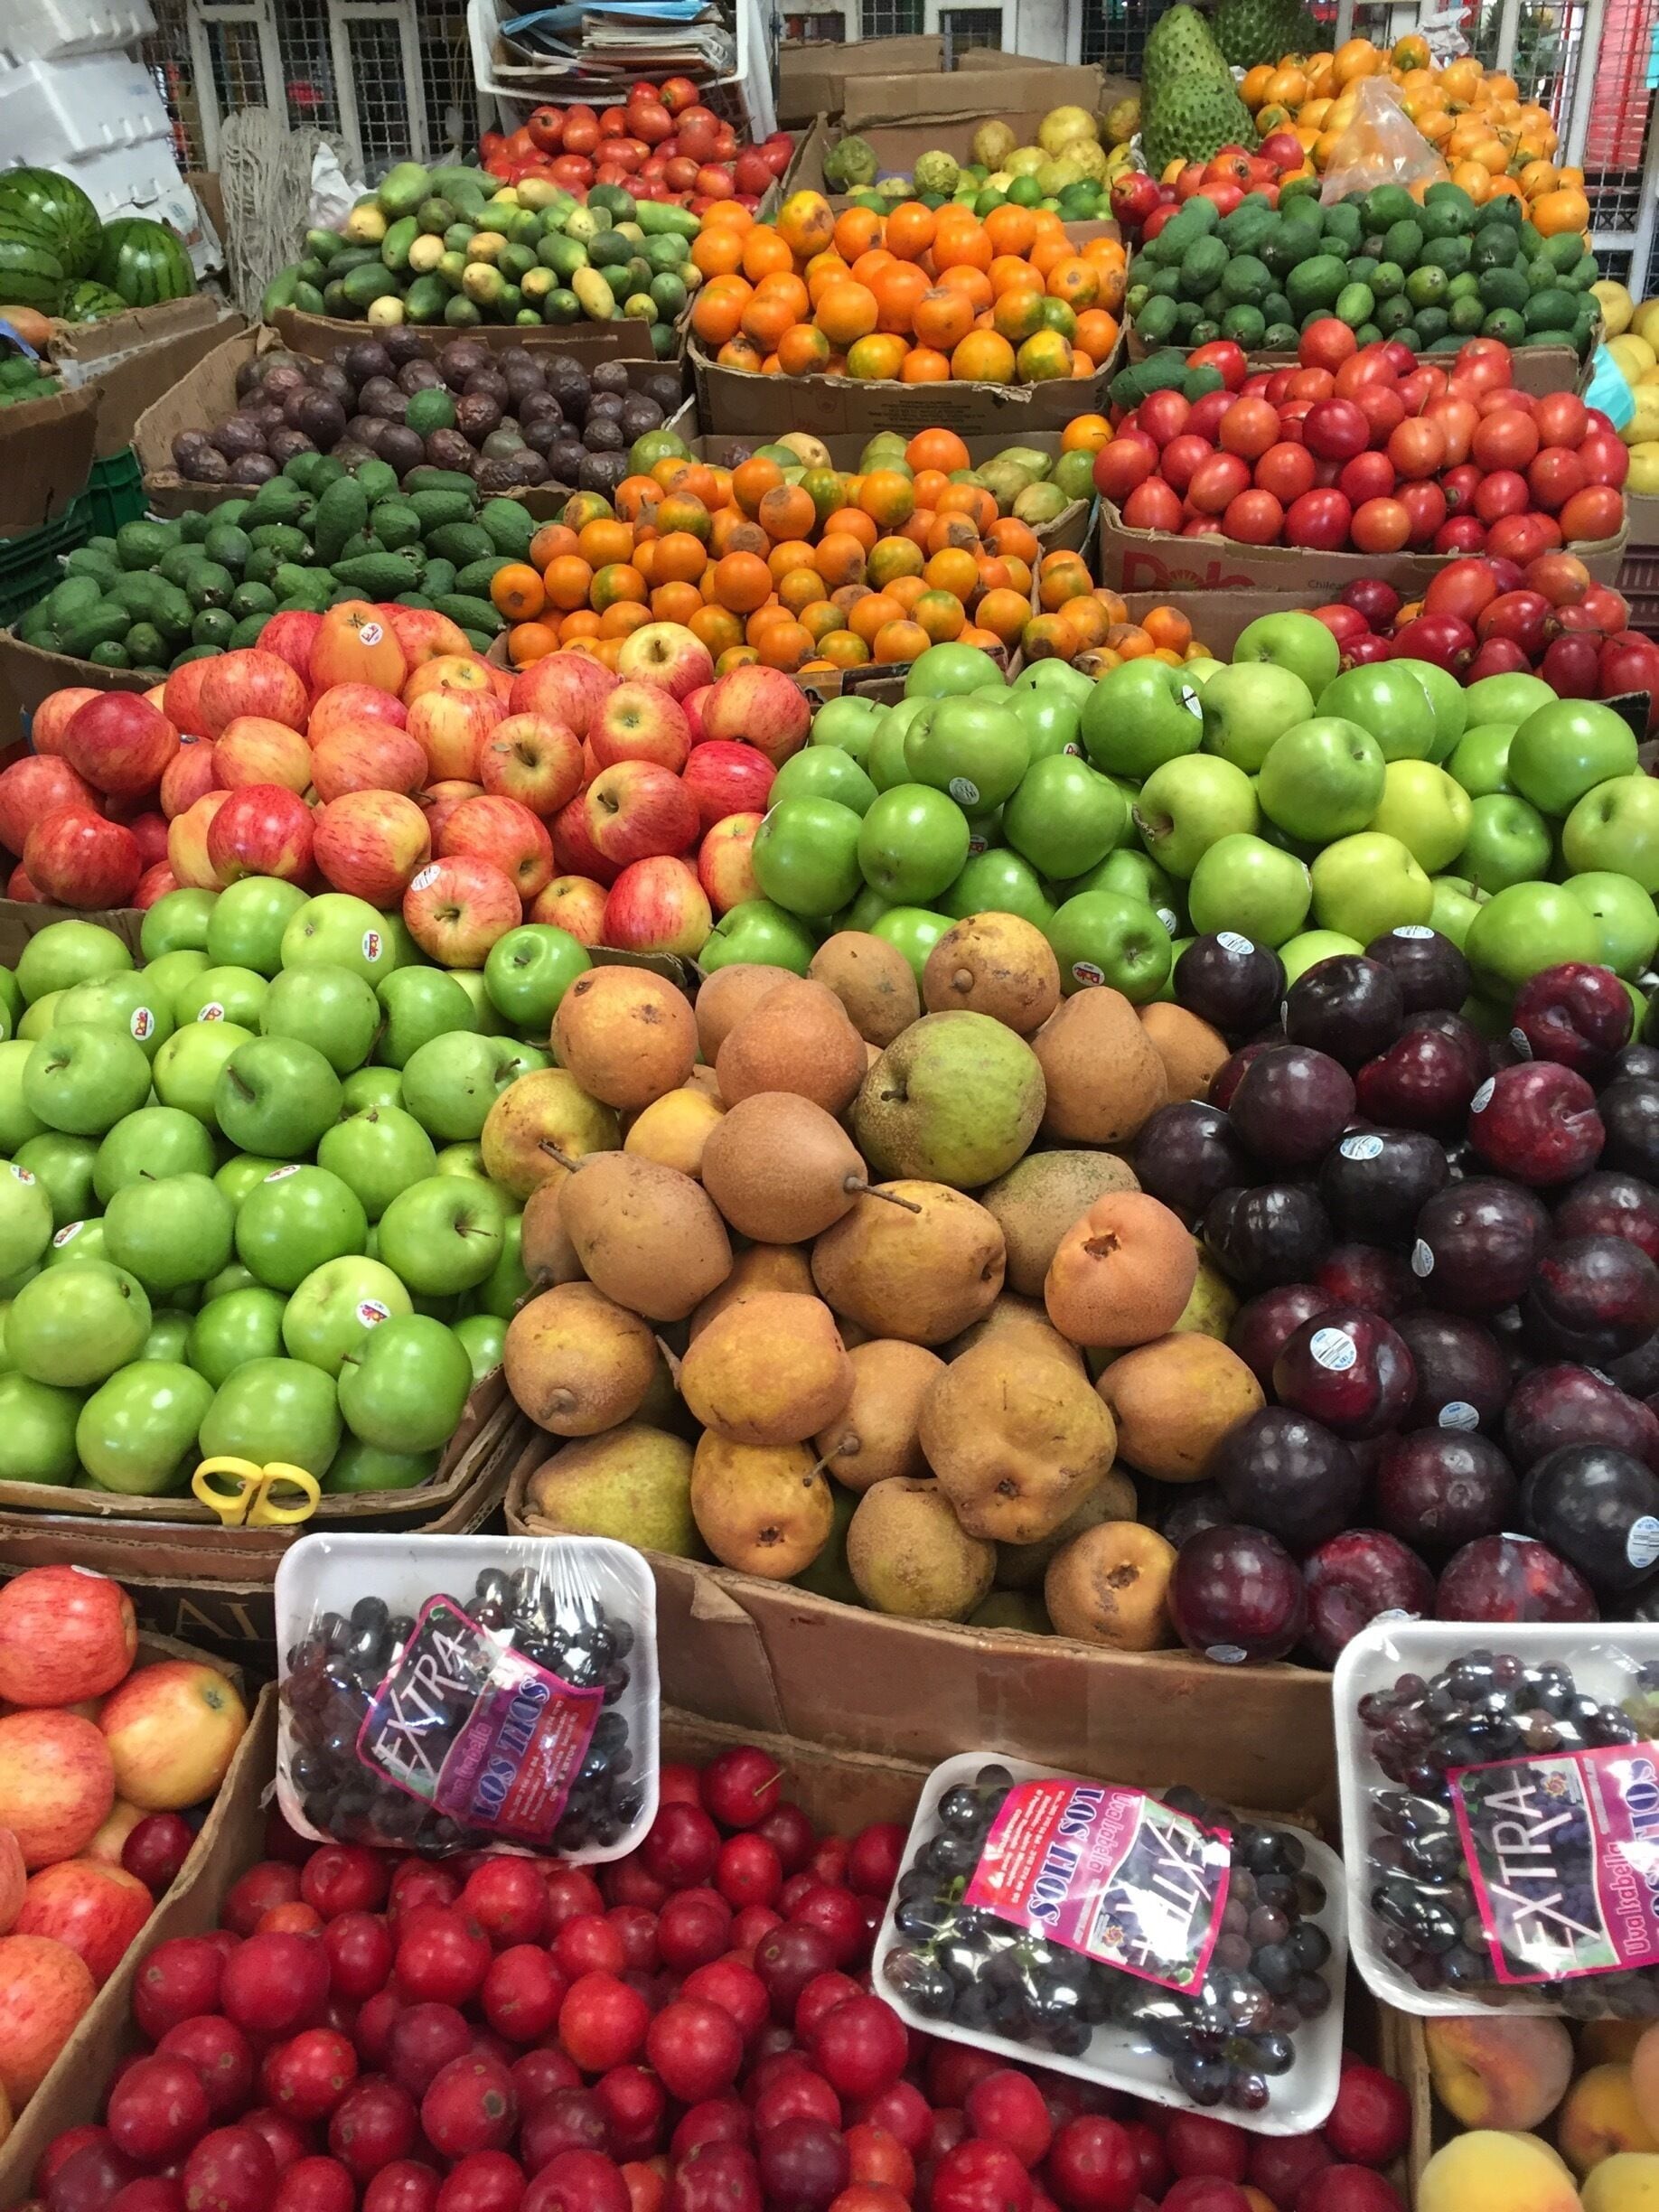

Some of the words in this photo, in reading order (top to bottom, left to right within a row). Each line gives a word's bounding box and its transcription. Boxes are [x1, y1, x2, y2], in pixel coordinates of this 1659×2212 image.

[369, 933, 379, 957] Dole
[1076, 967, 1100, 984] Dole
[135, 1011, 148, 1036] Dole
[372, 1628, 469, 1778] EXTRA
[471, 1754, 517, 1821] LOS
[495, 1675, 550, 1757] TIOS
[1057, 1786, 1105, 1842] LOS
[1086, 1819, 1125, 1873] Isabella
[1483, 1769, 1601, 1964] EXTRA
[1026, 1842, 1084, 1926] TIOS
[1623, 1915, 1652, 1956] Uva
